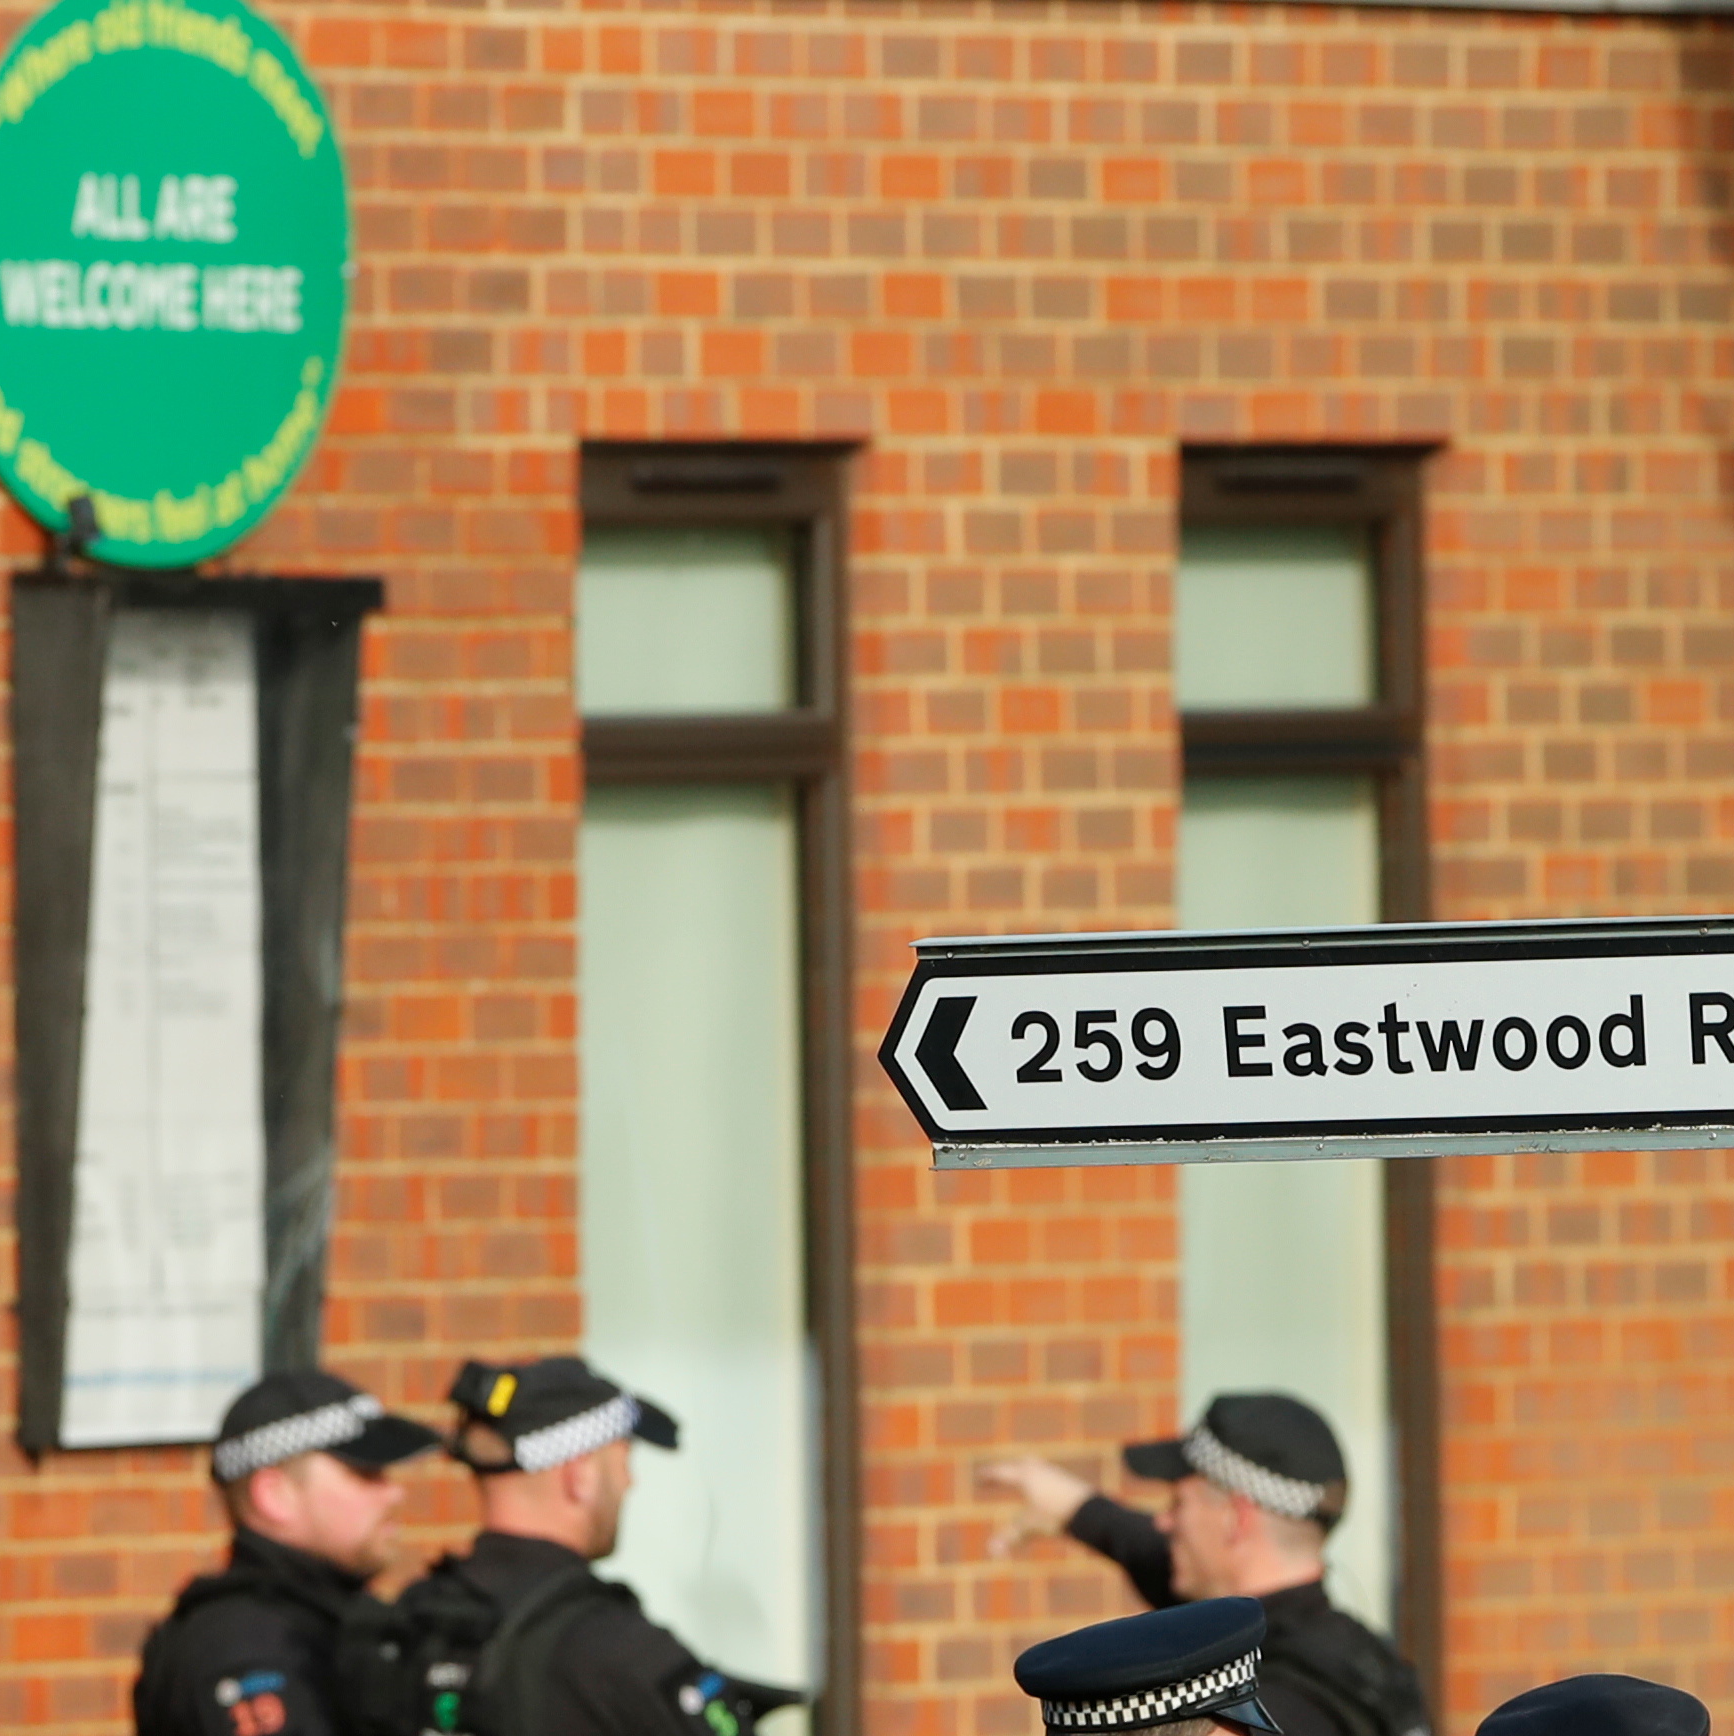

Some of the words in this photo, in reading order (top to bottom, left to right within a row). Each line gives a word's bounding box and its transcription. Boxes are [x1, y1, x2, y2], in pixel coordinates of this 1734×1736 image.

[72, 172, 151, 240] ALL
[154, 174, 237, 243] ARE
[202, 265, 303, 334] HERE
[1010, 1007, 1181, 1083] 259
[1223, 994, 1647, 1077] Eastwood
